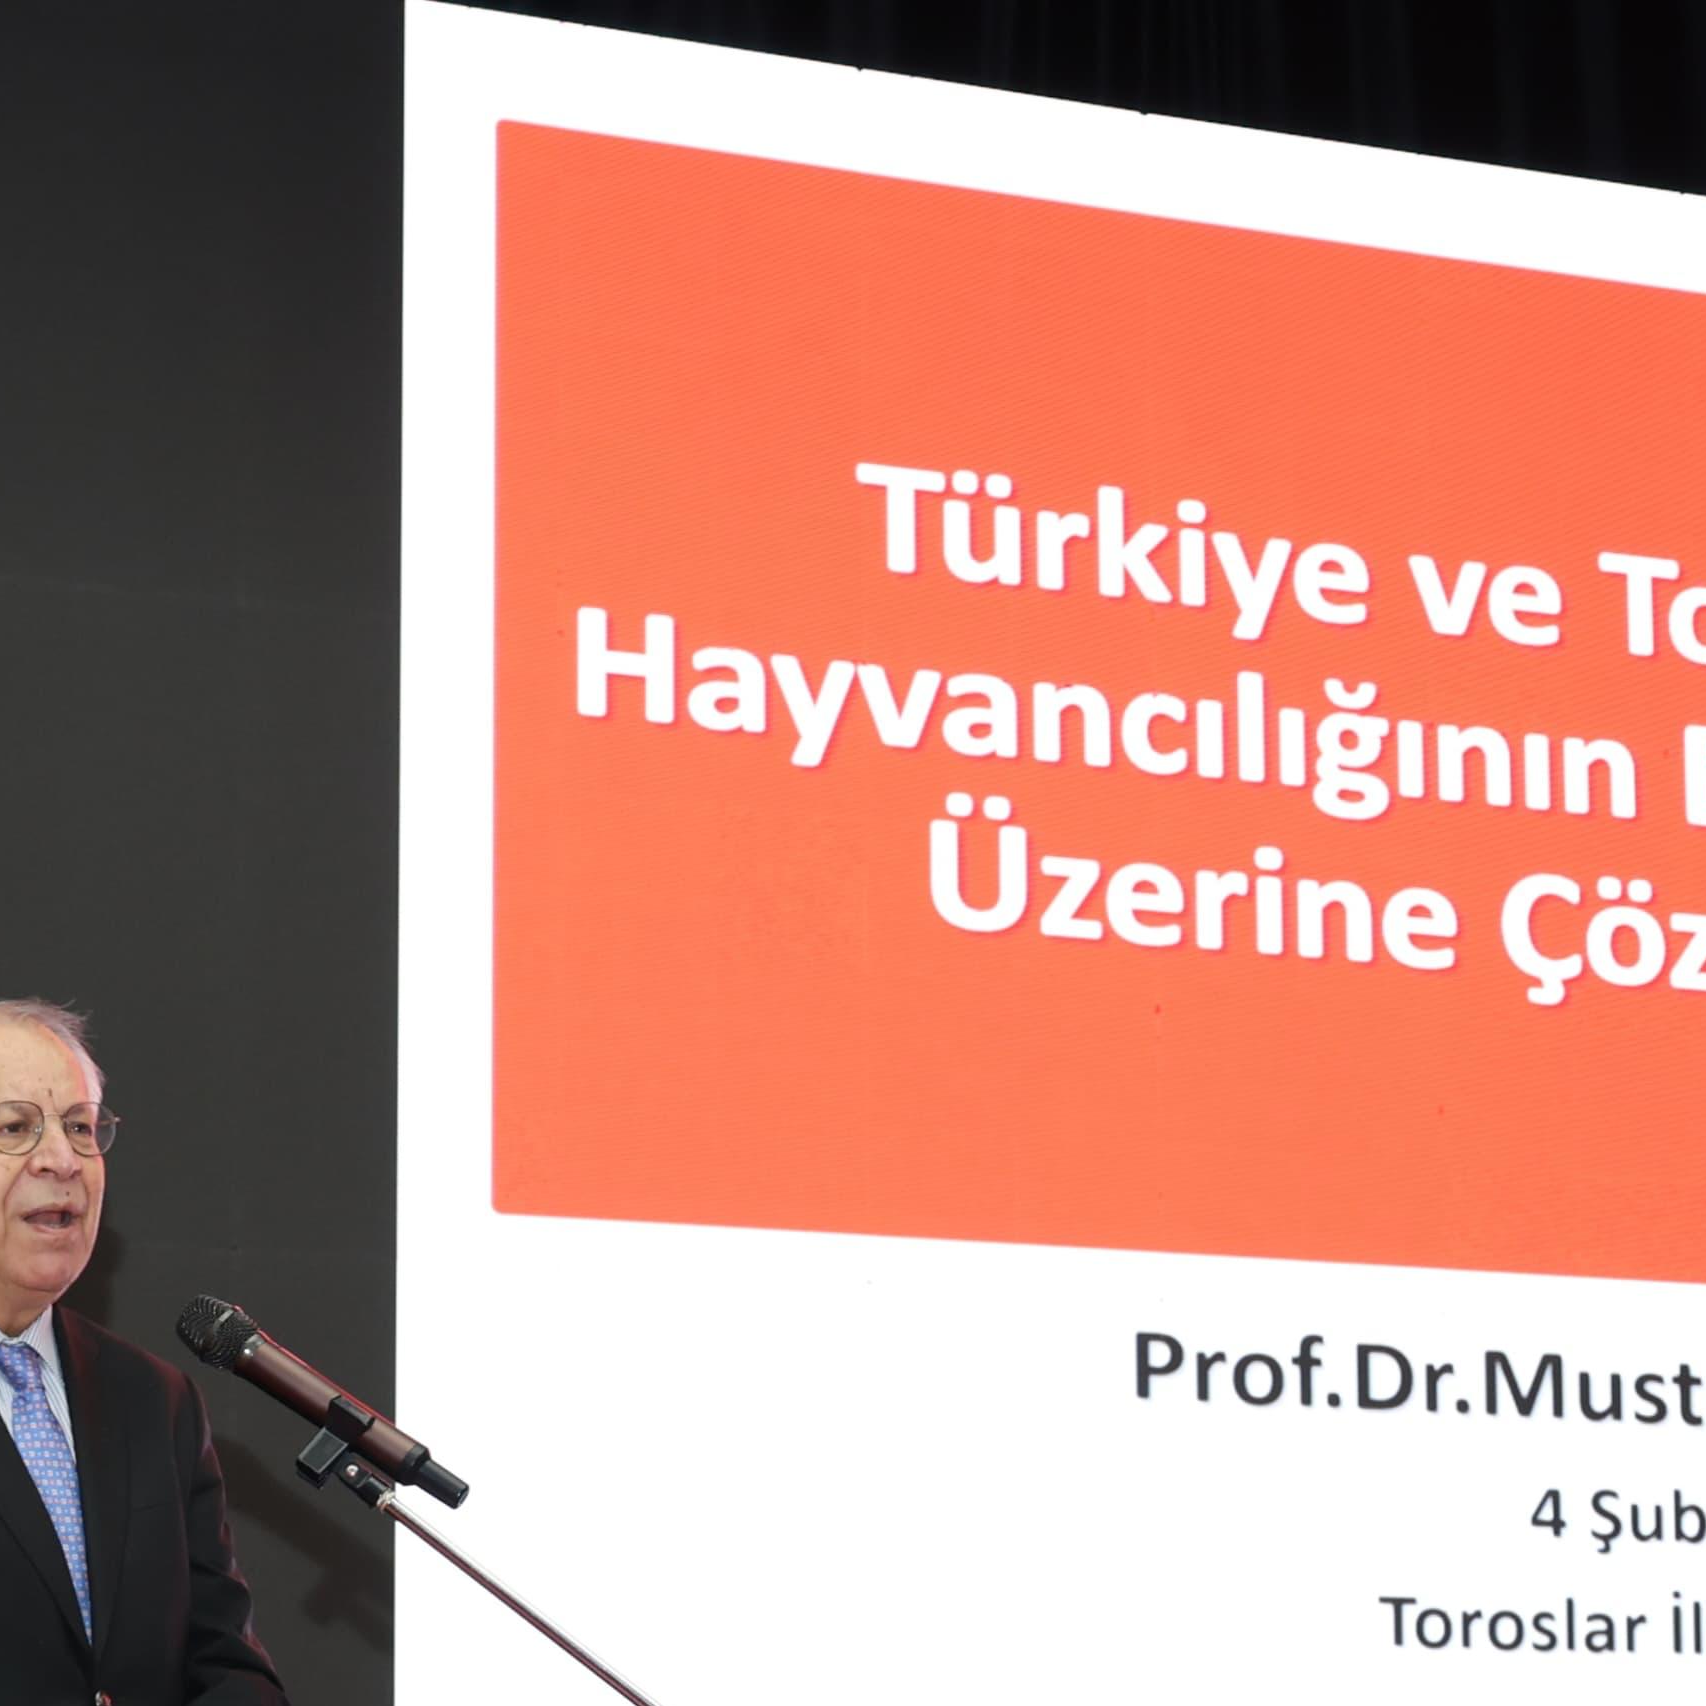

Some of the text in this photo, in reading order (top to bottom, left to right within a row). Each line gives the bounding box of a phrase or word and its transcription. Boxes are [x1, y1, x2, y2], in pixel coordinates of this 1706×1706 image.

[855, 462, 1370, 641] Türkiye
[1408, 554, 1563, 647] ve
[576, 606, 1637, 821] Hayvancılığının
[929, 792, 1459, 971] Üzerine
[1531, 1489, 1567, 1538] 4
[1379, 1597, 1647, 1653] Toroslar
